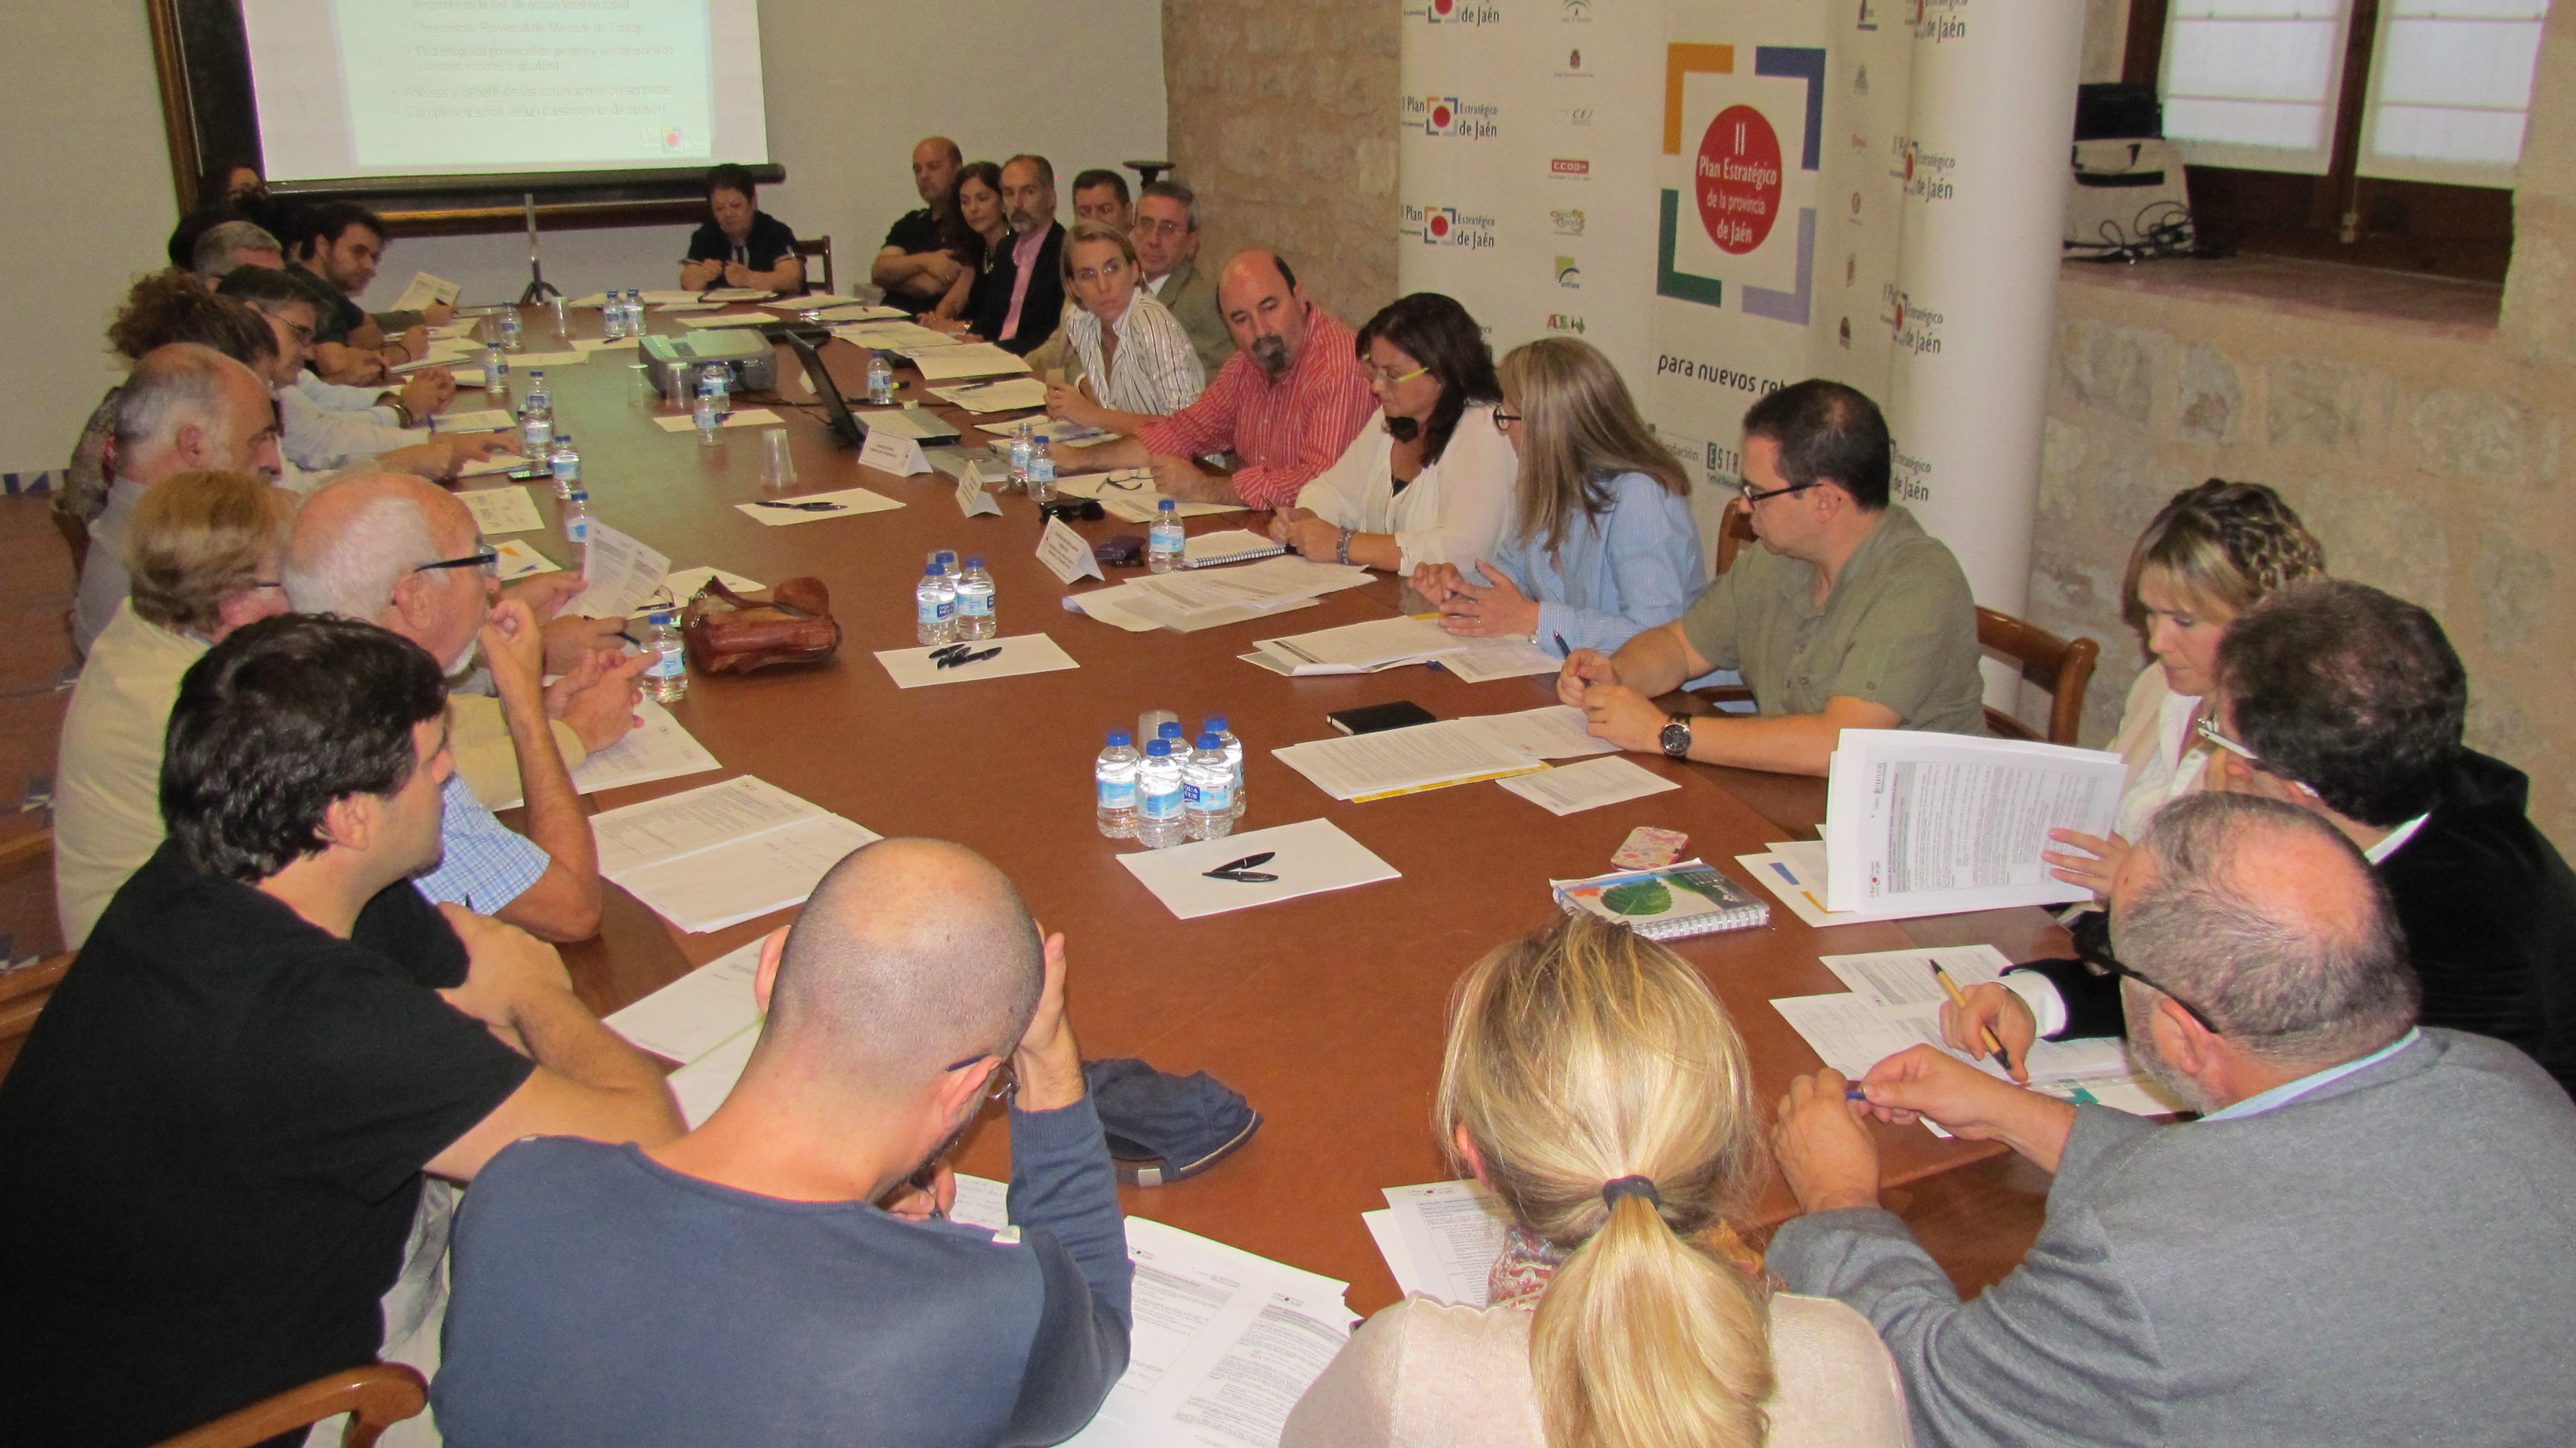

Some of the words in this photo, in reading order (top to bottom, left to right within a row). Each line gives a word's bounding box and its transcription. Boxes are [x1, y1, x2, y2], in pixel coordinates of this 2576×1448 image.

[1461, 8, 1474, 22] de
[1477, 7, 1499, 26] Jaén
[1937, 15, 1965, 43] Jaén
[1407, 96, 1425, 113] Plan
[1459, 103, 1497, 119] Estratégico
[1459, 120, 1472, 136] de
[1474, 120, 1497, 140] Jaén
[1735, 123, 1746, 156] II
[1699, 156, 1720, 178] Plan
[1724, 158, 1777, 191] Estratégico
[1926, 175, 1953, 203] Jaén
[1406, 204, 1423, 221] Plan
[1707, 189, 1717, 208] de
[1719, 189, 1726, 209] la
[1728, 195, 1765, 215] provincia
[1457, 214, 1495, 229] Estratégico
[1717, 219, 1729, 240] de
[1729, 220, 1752, 246] Jaén
[1457, 230, 1470, 246] de
[1472, 231, 1494, 250] Jaén
[1915, 329, 1941, 355] Jaén
[1657, 354, 1693, 377] para
[1698, 363, 1757, 392] nuevos
[1761, 379, 1787, 396] ret
[1902, 476, 1929, 501] Jaén
[1184, 785, 1198, 794] QUA
[1185, 791, 1198, 800] EUS
